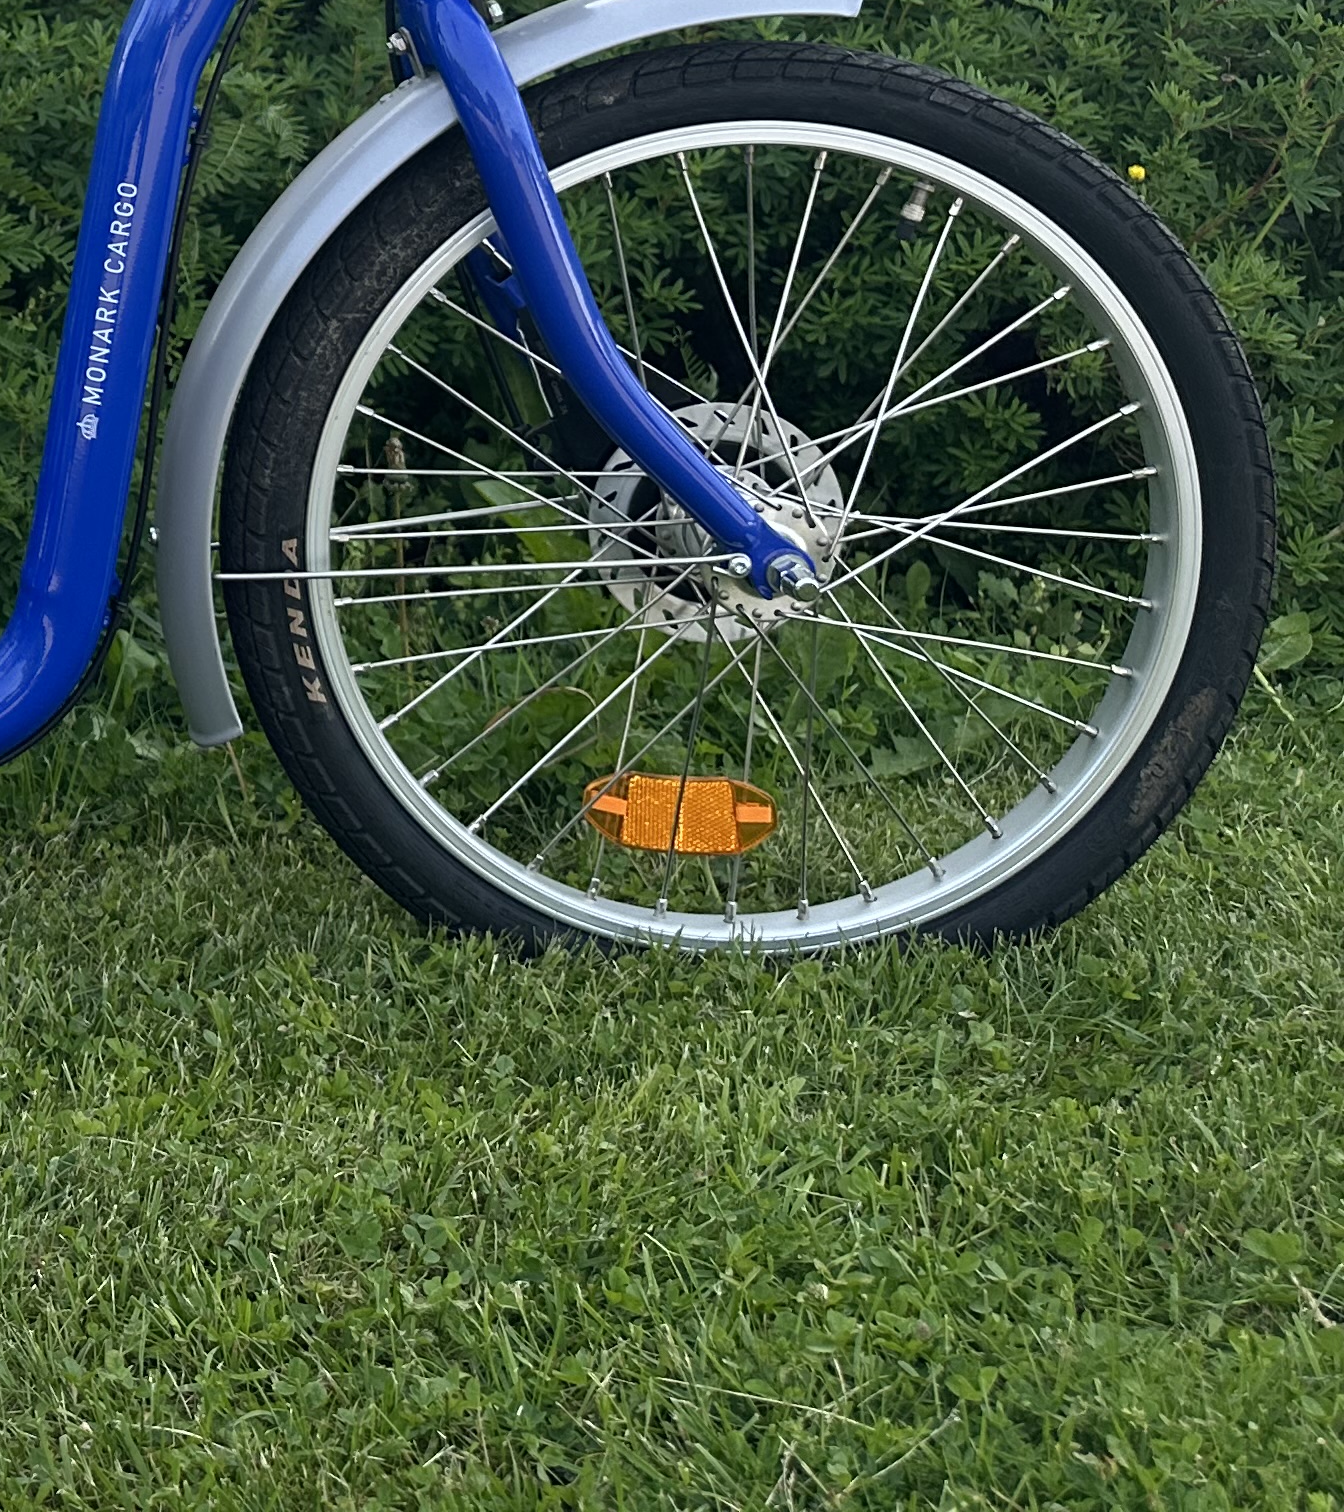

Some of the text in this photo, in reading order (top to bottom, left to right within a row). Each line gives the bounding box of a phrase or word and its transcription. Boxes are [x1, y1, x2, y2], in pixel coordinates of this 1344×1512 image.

[81, 182, 138, 406] MONARK CARGO
[281, 538, 327, 703] KENDA
